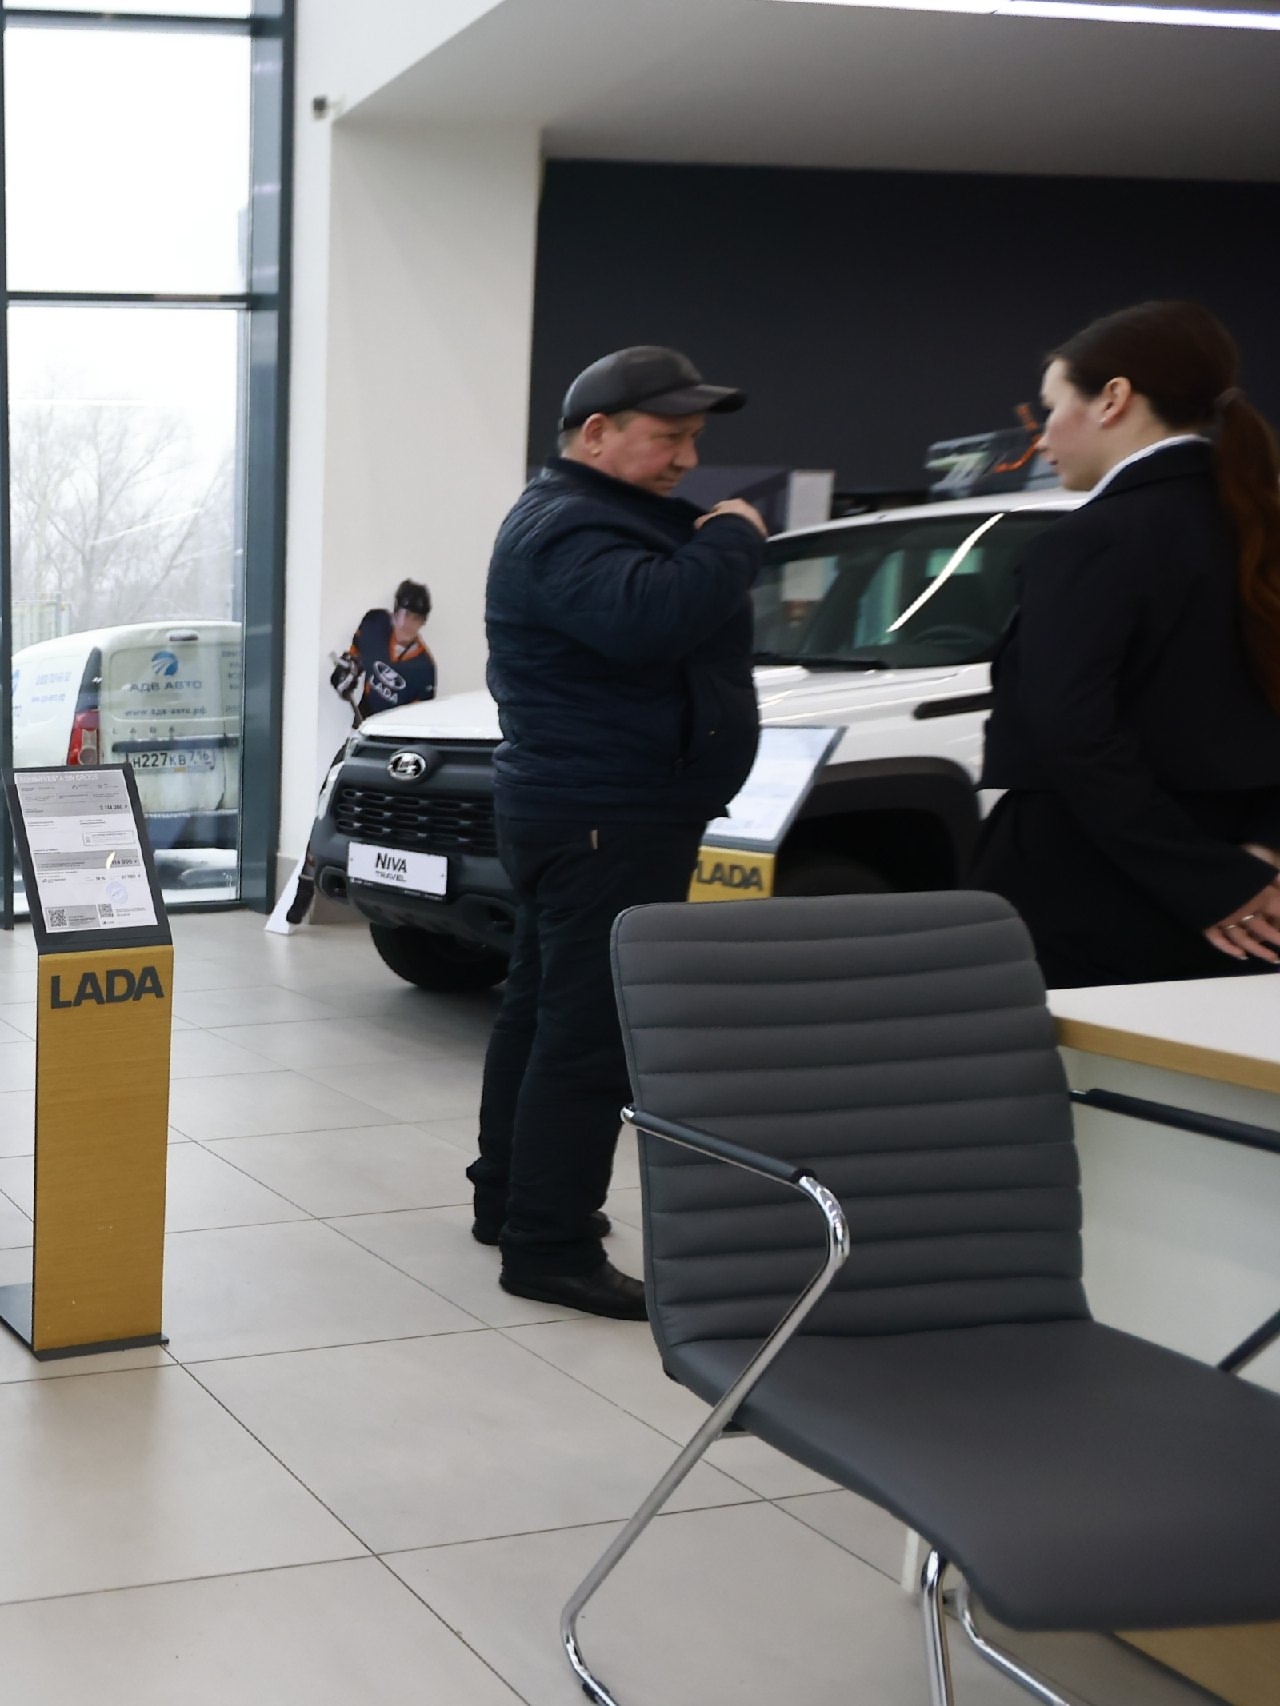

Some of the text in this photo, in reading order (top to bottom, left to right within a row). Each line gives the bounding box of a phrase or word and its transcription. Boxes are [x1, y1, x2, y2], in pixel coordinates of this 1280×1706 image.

[129, 679, 203, 692] АДВ АВТО
[369, 674, 398, 704] LADA
[375, 852, 407, 873] NIVA
[375, 870, 407, 882] TRAVEL
[697, 860, 763, 891] LADA
[50, 966, 164, 1010] LADA
